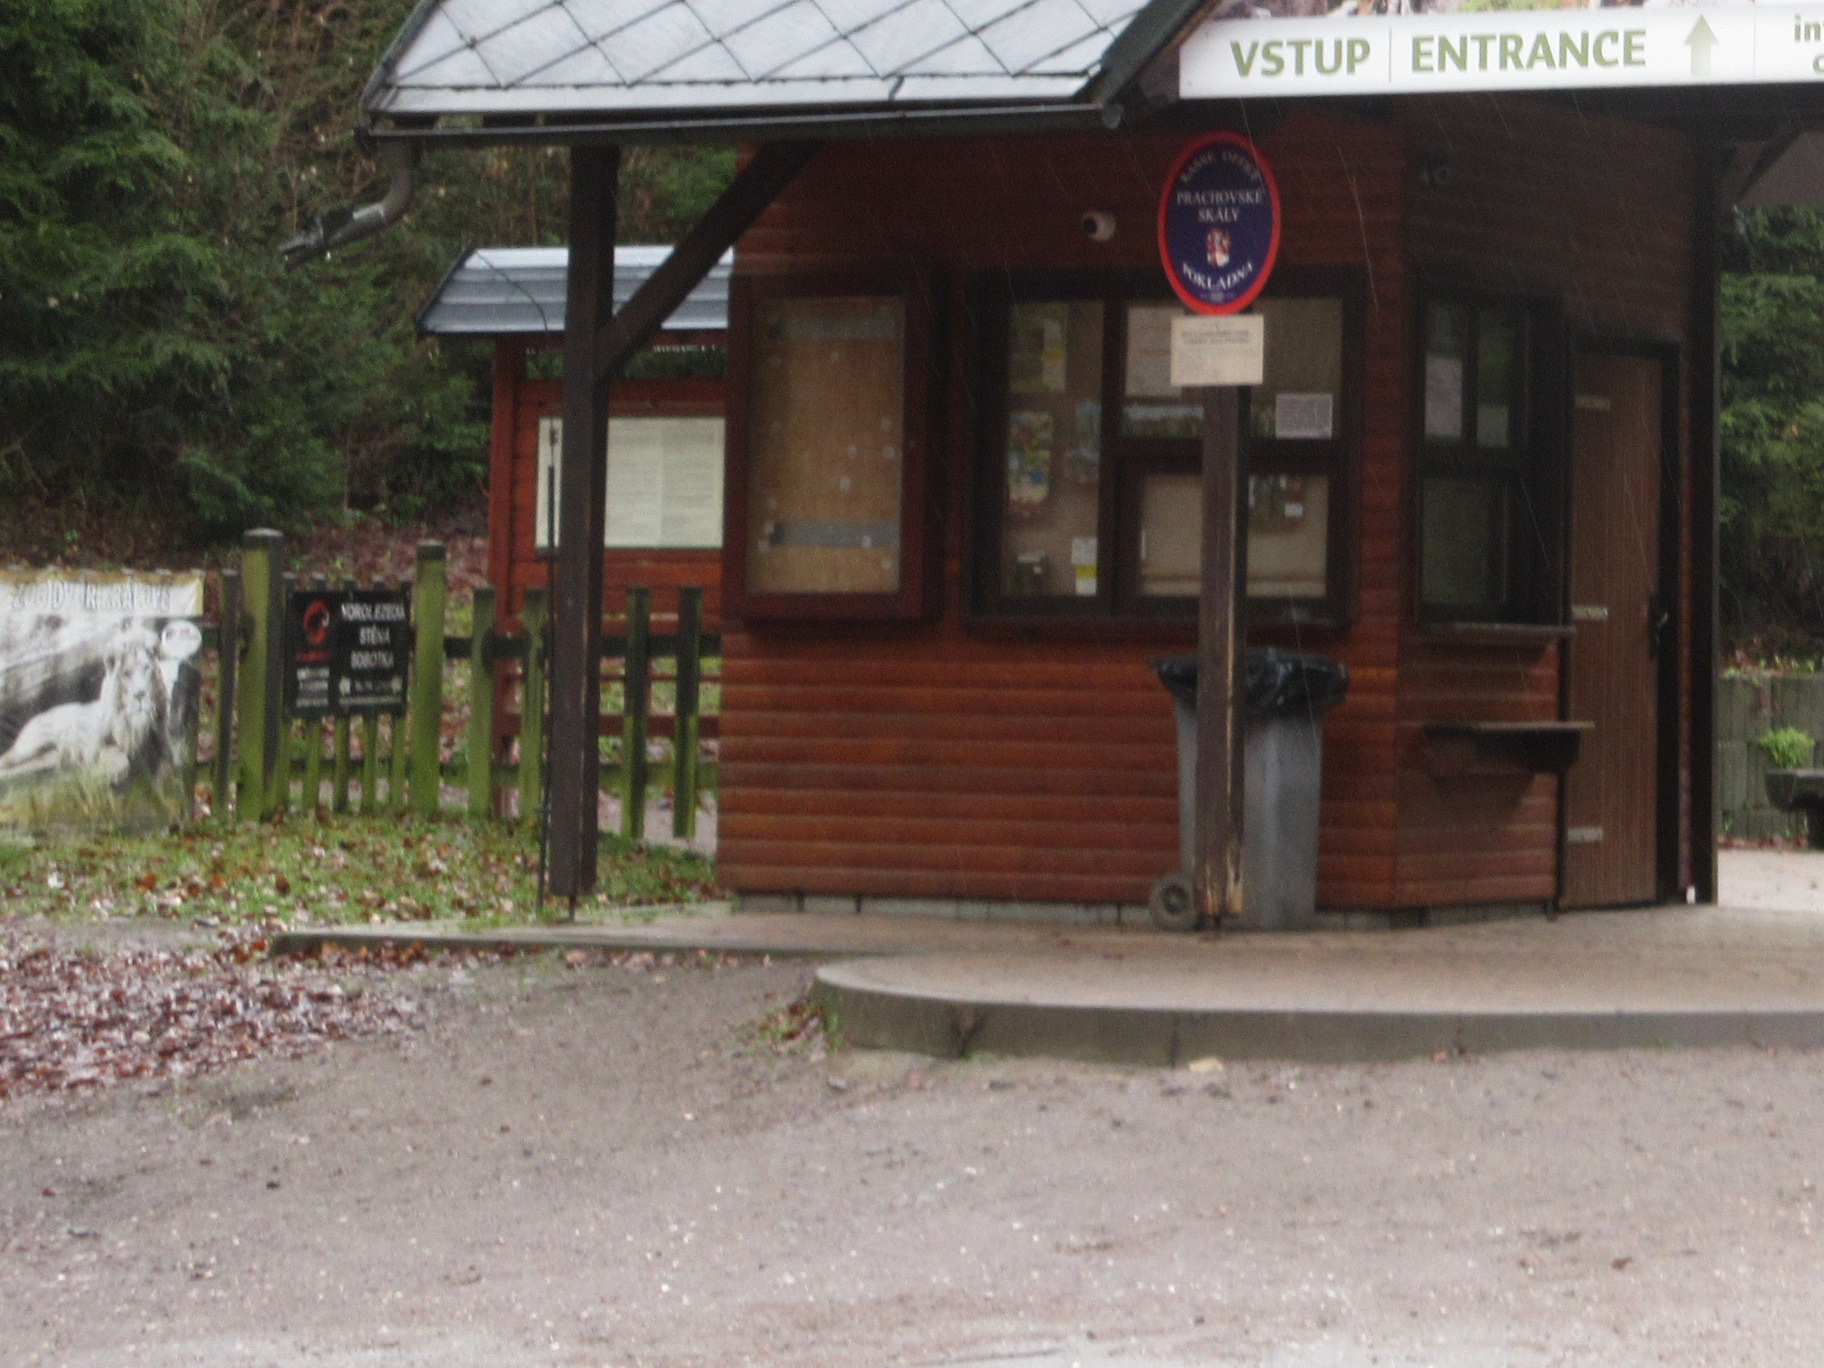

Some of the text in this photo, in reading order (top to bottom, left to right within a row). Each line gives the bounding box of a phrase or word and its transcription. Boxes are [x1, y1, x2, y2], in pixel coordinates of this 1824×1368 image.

[1230, 28, 1647, 77] VSTUP ENTRANCE
[1176, 187, 1262, 206] PRACHOVSKÉ
[1183, 260, 1253, 290] POKLADNA
